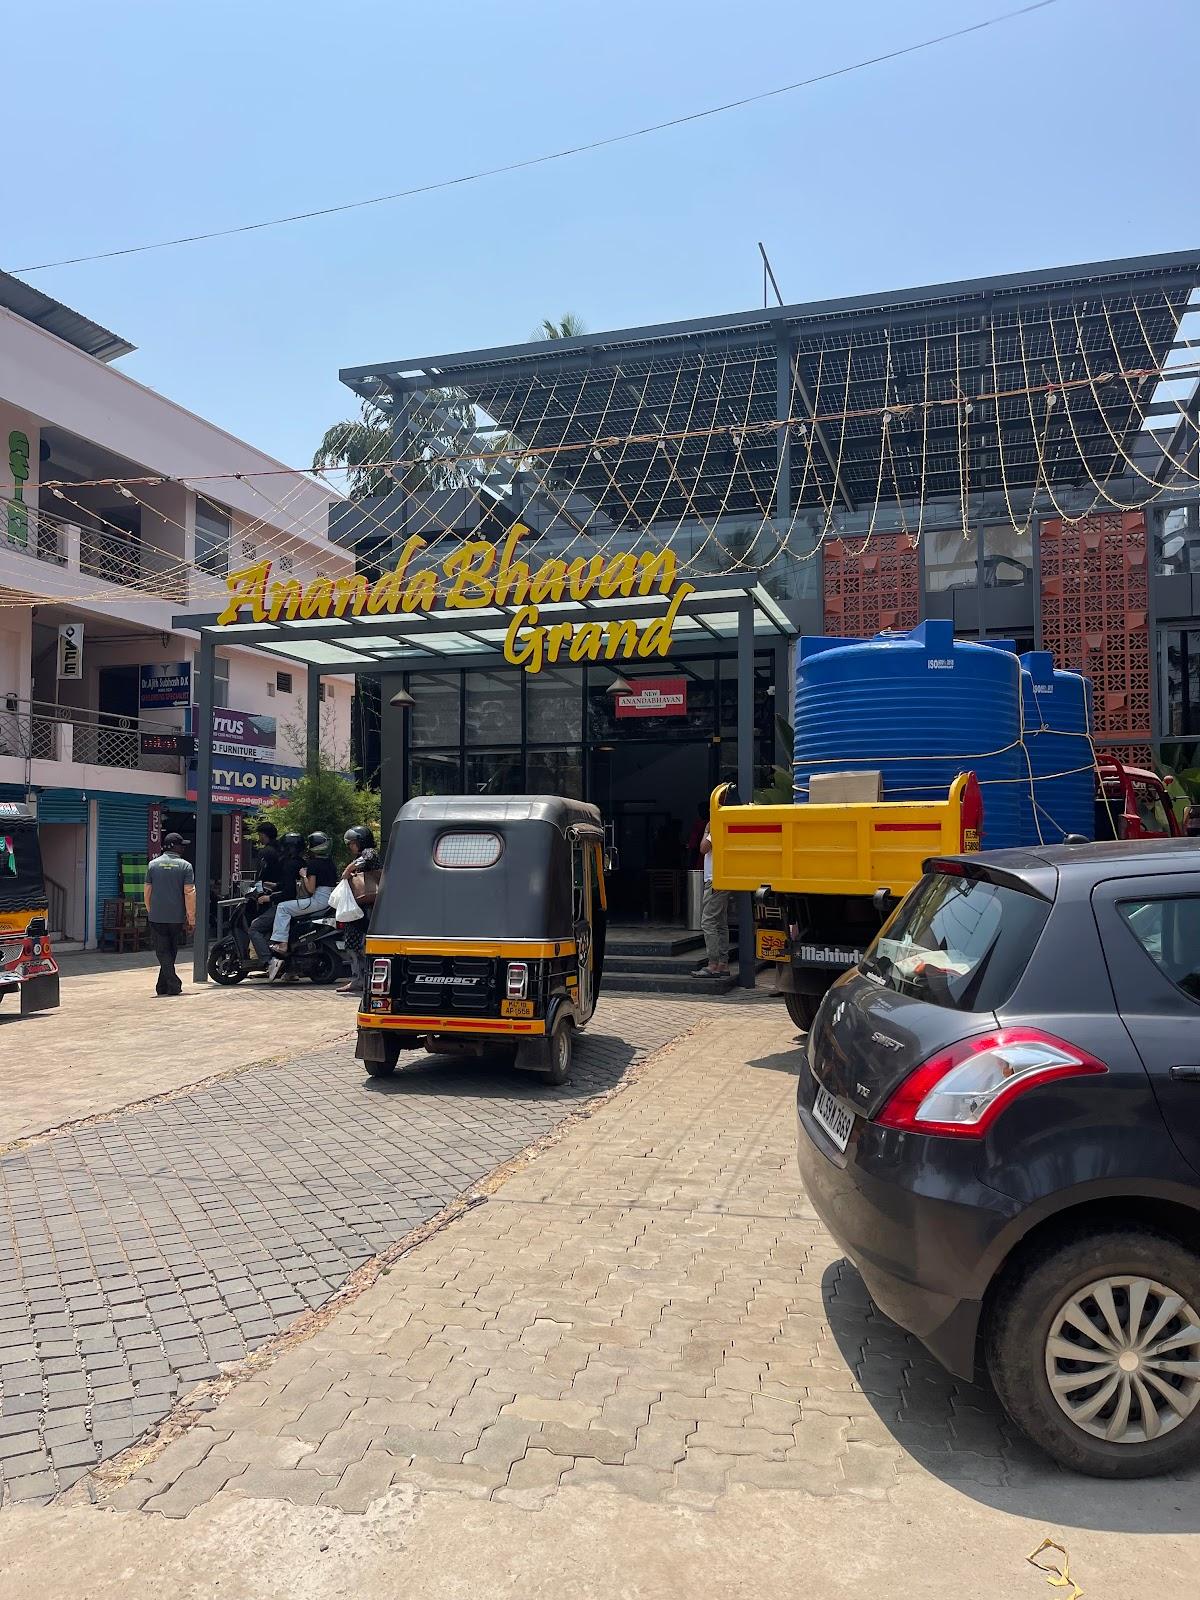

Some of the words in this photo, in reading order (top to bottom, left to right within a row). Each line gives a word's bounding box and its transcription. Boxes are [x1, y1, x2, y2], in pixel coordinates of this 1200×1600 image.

[217, 534, 439, 626] Ananda
[442, 523, 678, 609] Bhavan
[504, 582, 696, 674] Grand
[622, 696, 681, 705] ANANDABHAVAN
[219, 743, 257, 756] FURNITURE
[212, 769, 257, 788] TYLO
[151, 810, 160, 842] Cirrus
[232, 853, 240, 882] Cirrus
[871, 1031, 905, 1051] SWIFT
